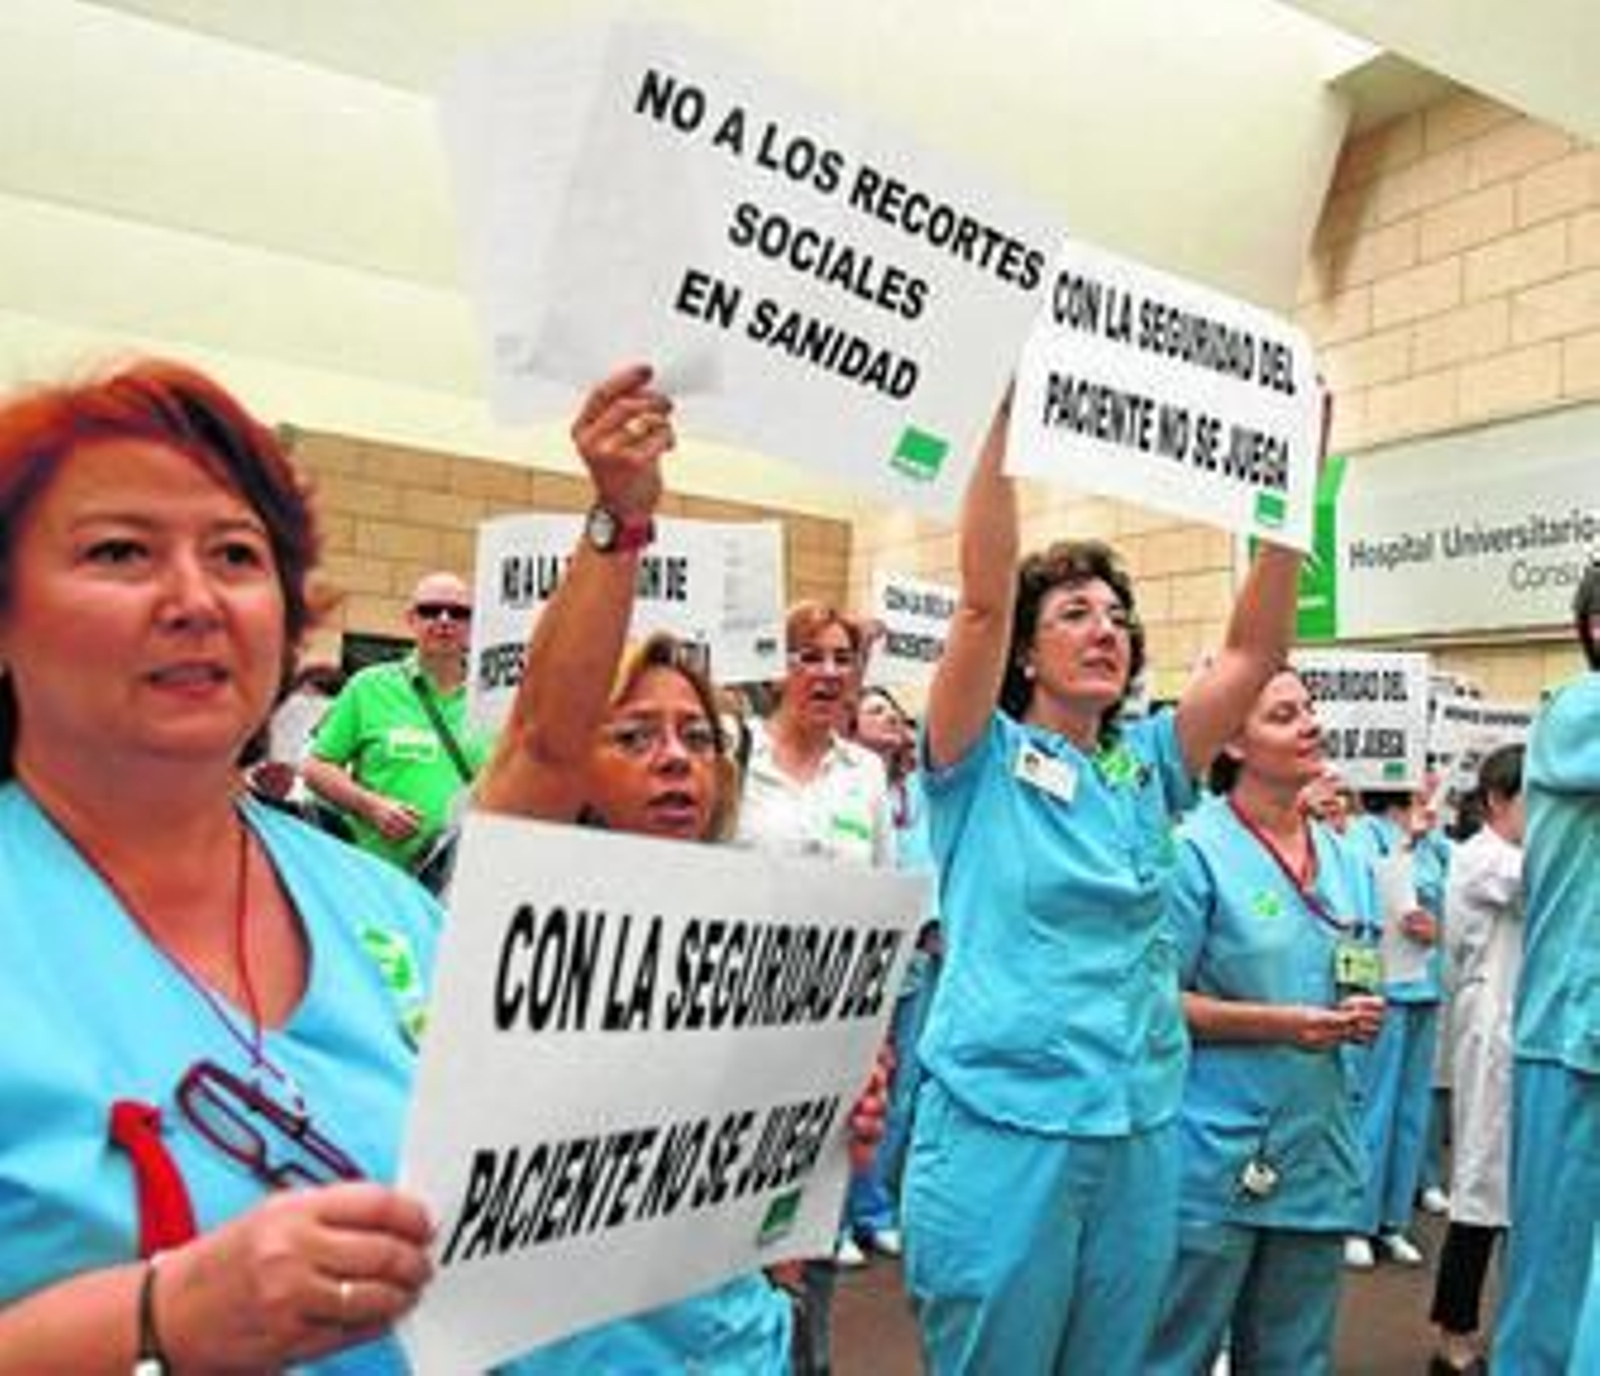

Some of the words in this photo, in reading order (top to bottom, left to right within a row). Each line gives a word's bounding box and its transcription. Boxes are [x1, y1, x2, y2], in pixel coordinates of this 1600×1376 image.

[634, 69, 706, 131] NO
[712, 107, 746, 155] A
[756, 123, 844, 194] LOS
[849, 166, 1046, 290] RECORTES
[728, 202, 929, 320] SOCIALES
[674, 269, 742, 329] EN
[747, 299, 919, 401] SANIDAD
[1052, 271, 1101, 335] CON
[1105, 288, 1133, 343] LA
[1139, 298, 1255, 381] SEGURIDAD
[1258, 336, 1296, 396] DEL
[1043, 371, 1155, 452] PACIENTE
[1157, 403, 1190, 461] NO
[1193, 413, 1221, 471] SE
[1222, 425, 1289, 490] JUEGA
[1349, 531, 1434, 571] Hospital
[493, 904, 606, 1032] CON
[602, 914, 663, 1032] LA
[664, 919, 856, 1031] SEGURIDAD
[838, 929, 903, 1021] DEL
[440, 1126, 661, 1266] PACIENTE
[638, 1117, 709, 1220] NO
[690, 1109, 755, 1209] SE
[733, 1094, 840, 1199] JUEGA
